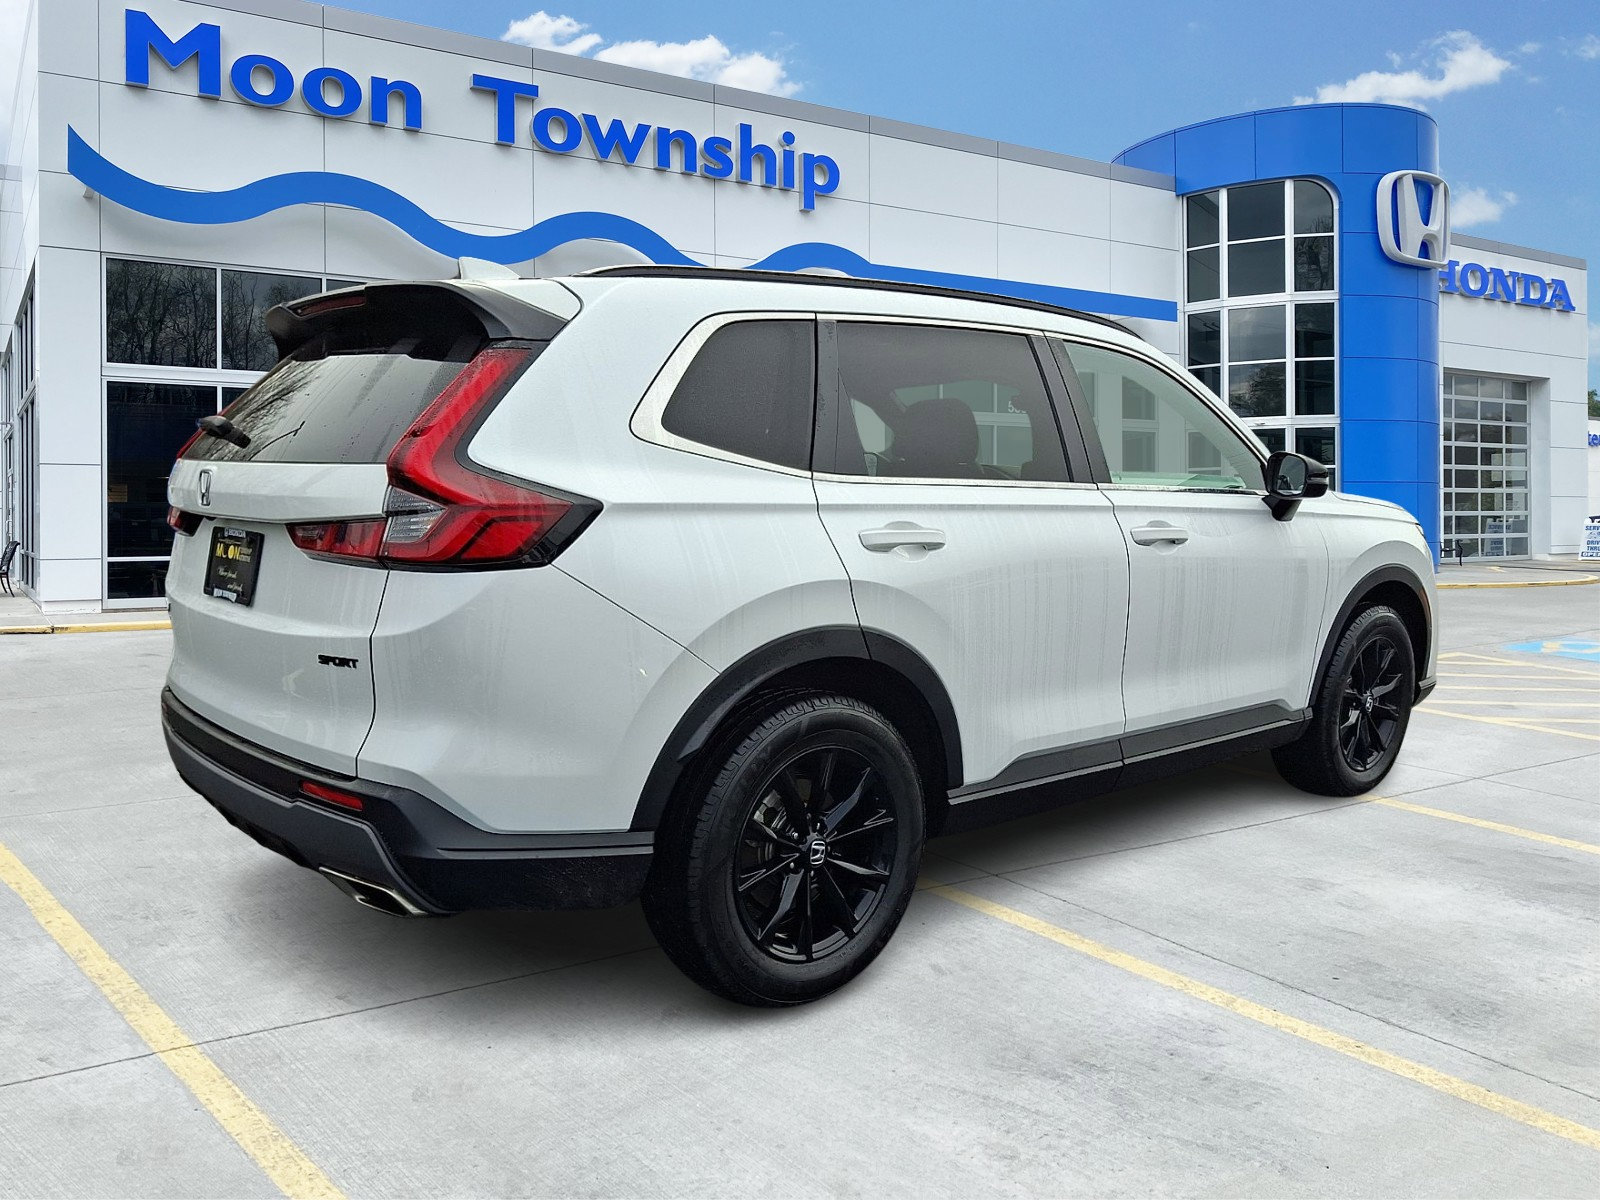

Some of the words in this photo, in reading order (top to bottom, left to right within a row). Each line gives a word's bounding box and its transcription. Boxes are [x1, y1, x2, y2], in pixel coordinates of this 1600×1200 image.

[125, 9, 422, 131] Moon
[470, 73, 840, 212] Township
[318, 654, 359, 669] SPORT
